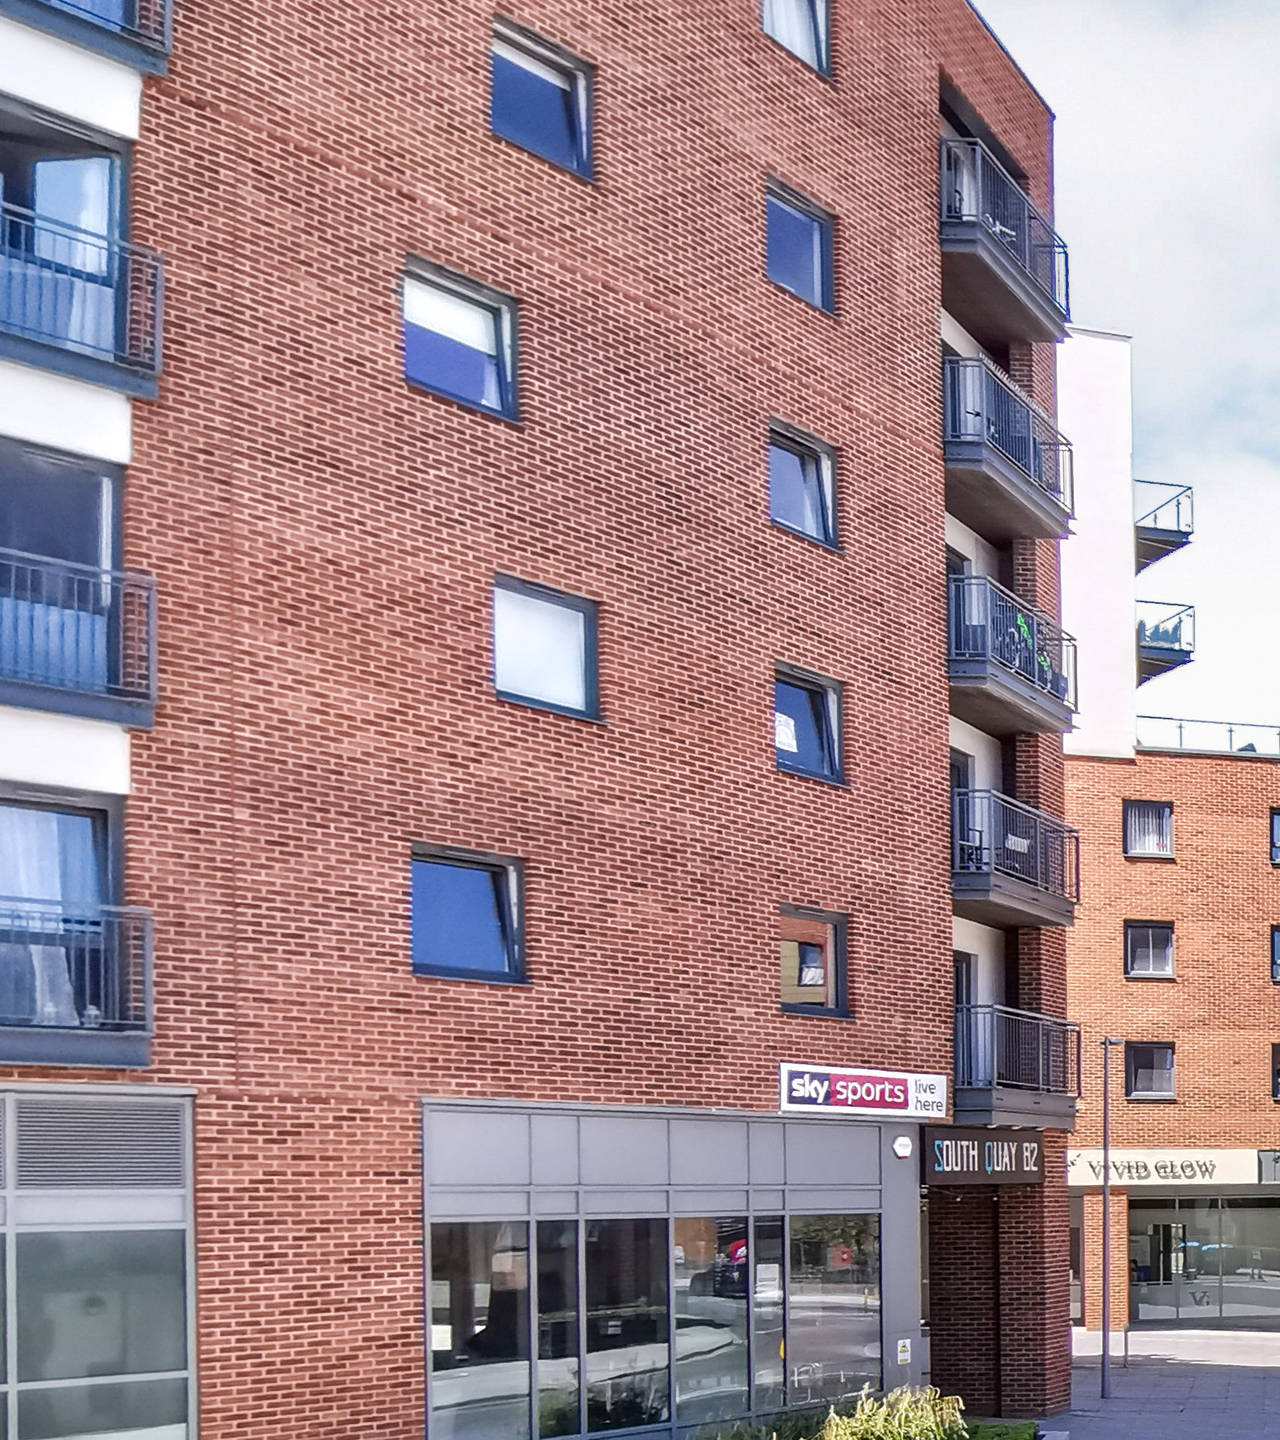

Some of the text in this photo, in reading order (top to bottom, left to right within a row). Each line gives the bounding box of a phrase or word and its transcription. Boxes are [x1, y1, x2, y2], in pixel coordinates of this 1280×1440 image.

[791, 1073, 905, 1105] sky sports
[915, 1079, 937, 1095] live
[915, 1097, 944, 1112] here
[934, 1140, 1039, 1174] SOUTH QUAY 82
[1088, 1160, 1216, 1179] VVID GLOW
